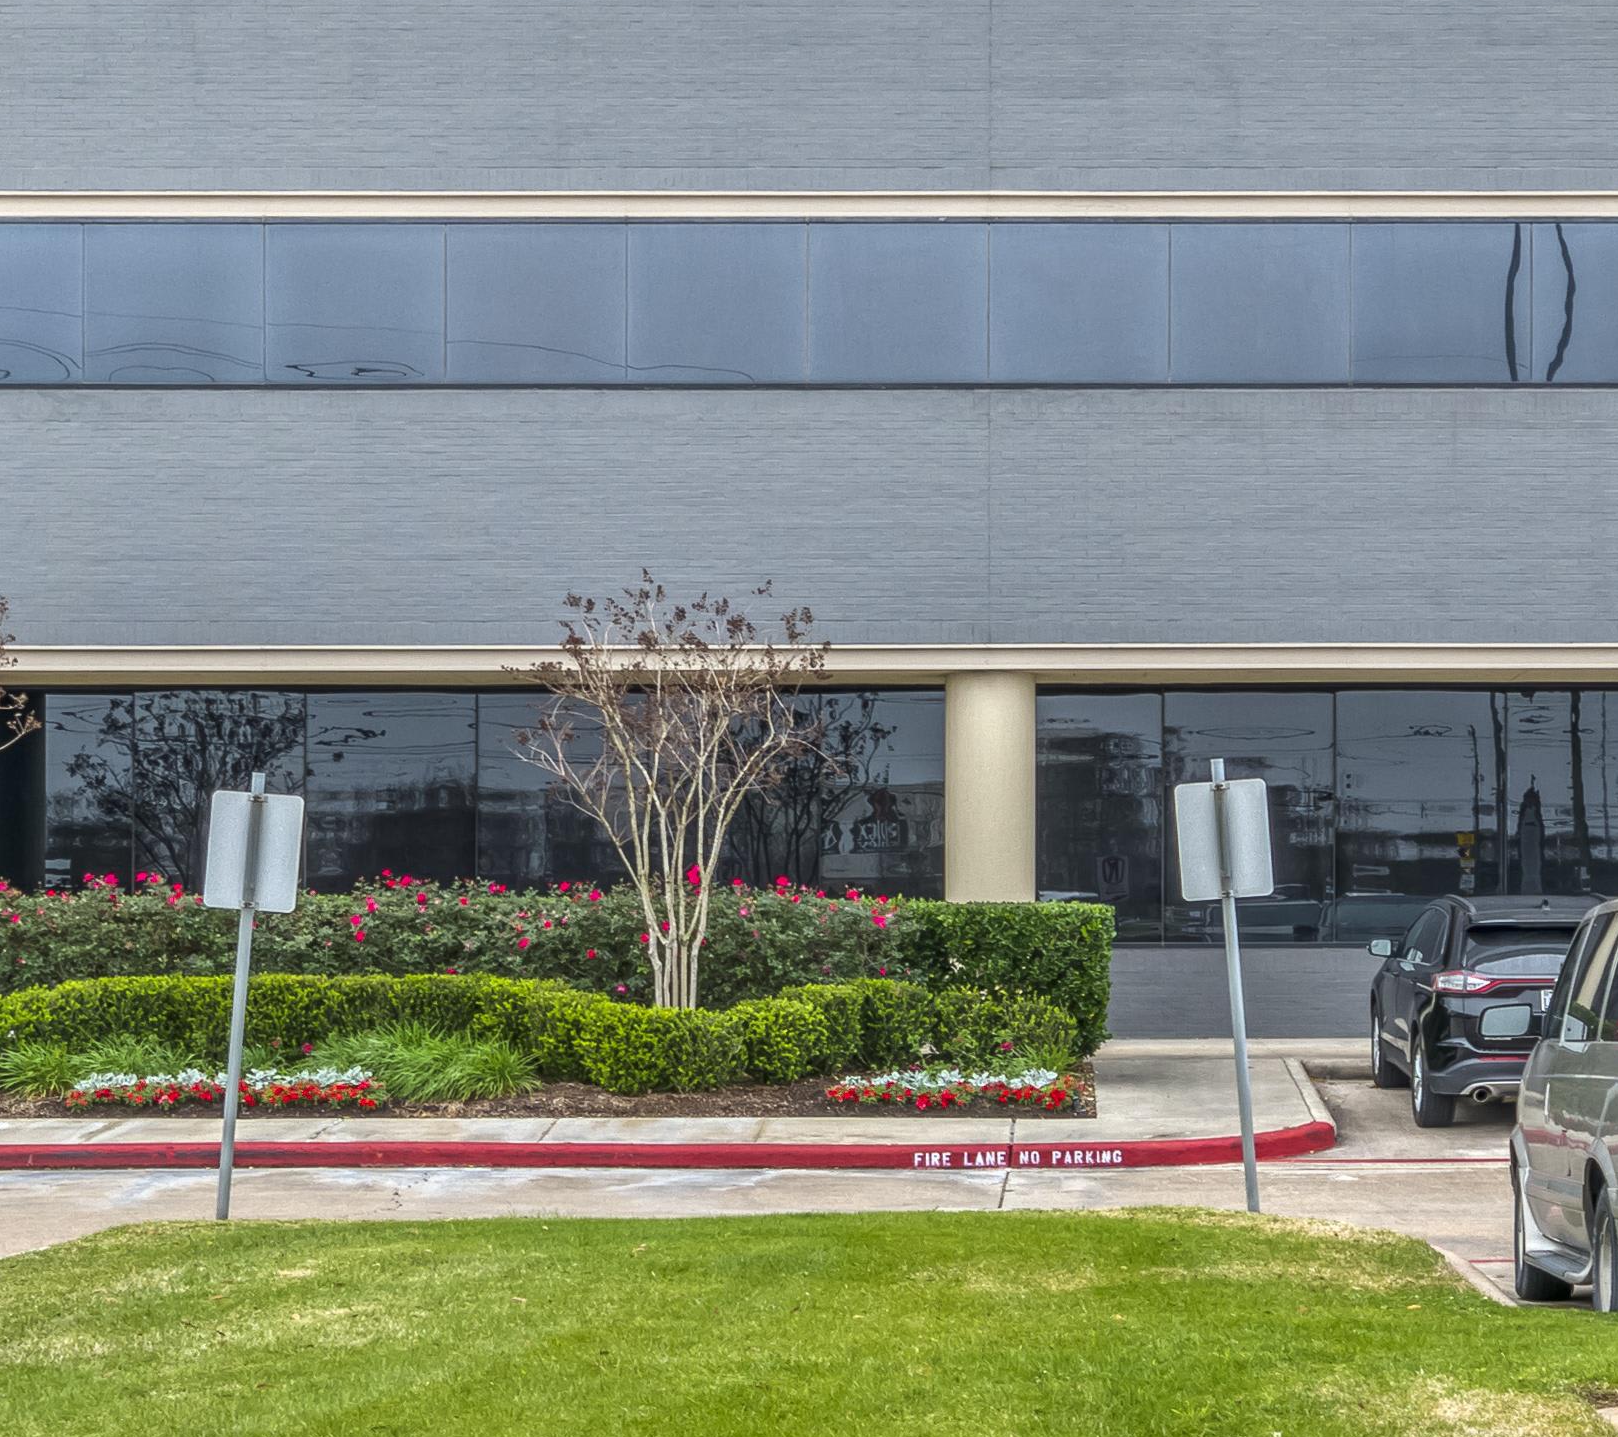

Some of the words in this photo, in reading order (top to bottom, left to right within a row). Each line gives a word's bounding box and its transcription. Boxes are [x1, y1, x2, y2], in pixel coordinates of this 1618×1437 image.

[913, 1151, 952, 1167] FIRE
[963, 1150, 1007, 1167] LANE
[1019, 1150, 1041, 1164] NO
[1052, 1149, 1123, 1164] PARKING
